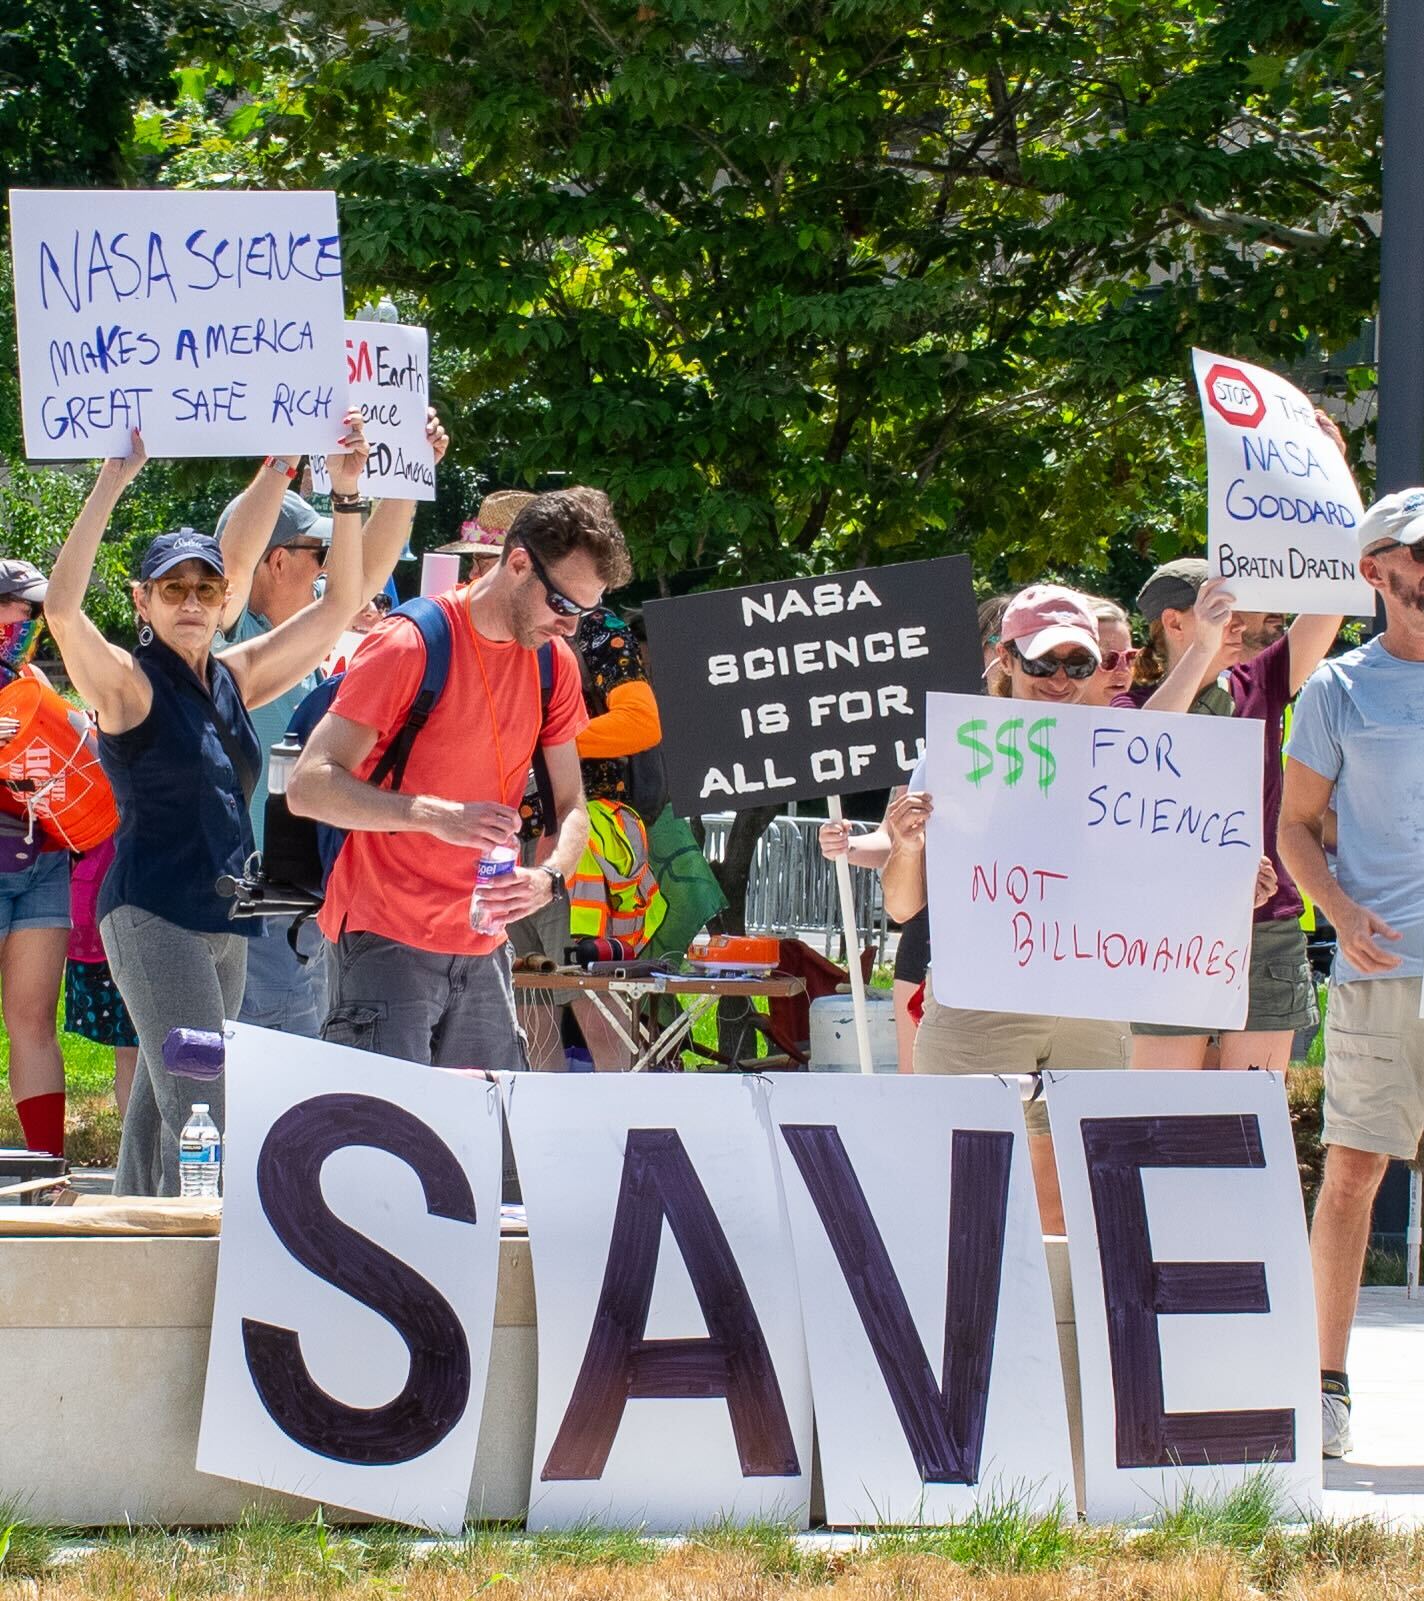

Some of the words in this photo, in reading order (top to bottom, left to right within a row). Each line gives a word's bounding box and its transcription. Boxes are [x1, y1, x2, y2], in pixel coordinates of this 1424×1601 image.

[41, 229, 177, 313] NASA
[185, 227, 342, 290] SCIENCE
[50, 325, 160, 387] MAKES
[176, 319, 313, 367] AMERICA
[376, 346, 424, 393] Earth
[42, 387, 152, 439] GREAT
[172, 381, 248, 423] SAFE
[272, 382, 332, 425] RICH
[361, 402, 401, 426] ence
[1215, 381, 1253, 407] STOP
[394, 447, 434, 488] America
[1241, 436, 1329, 481] NASA
[1226, 478, 1356, 529] GODDARD
[1218, 543, 1284, 579] BRAIN
[1288, 547, 1356, 581] DRAIN
[741, 577, 883, 627] NASA
[708, 624, 929, 686] SCIENCE
[742, 705, 790, 738] IS
[809, 685, 914, 727] FOR
[699, 757, 796, 799] ALL
[810, 744, 876, 783] OF
[895, 739, 927, 771] U
[956, 717, 1058, 796] $$$
[1091, 728, 1181, 778] FOR
[1088, 785, 1251, 848] SCIENCE
[972, 863, 1069, 905] NOT
[1012, 910, 1248, 991] BILLIONAIRES!
